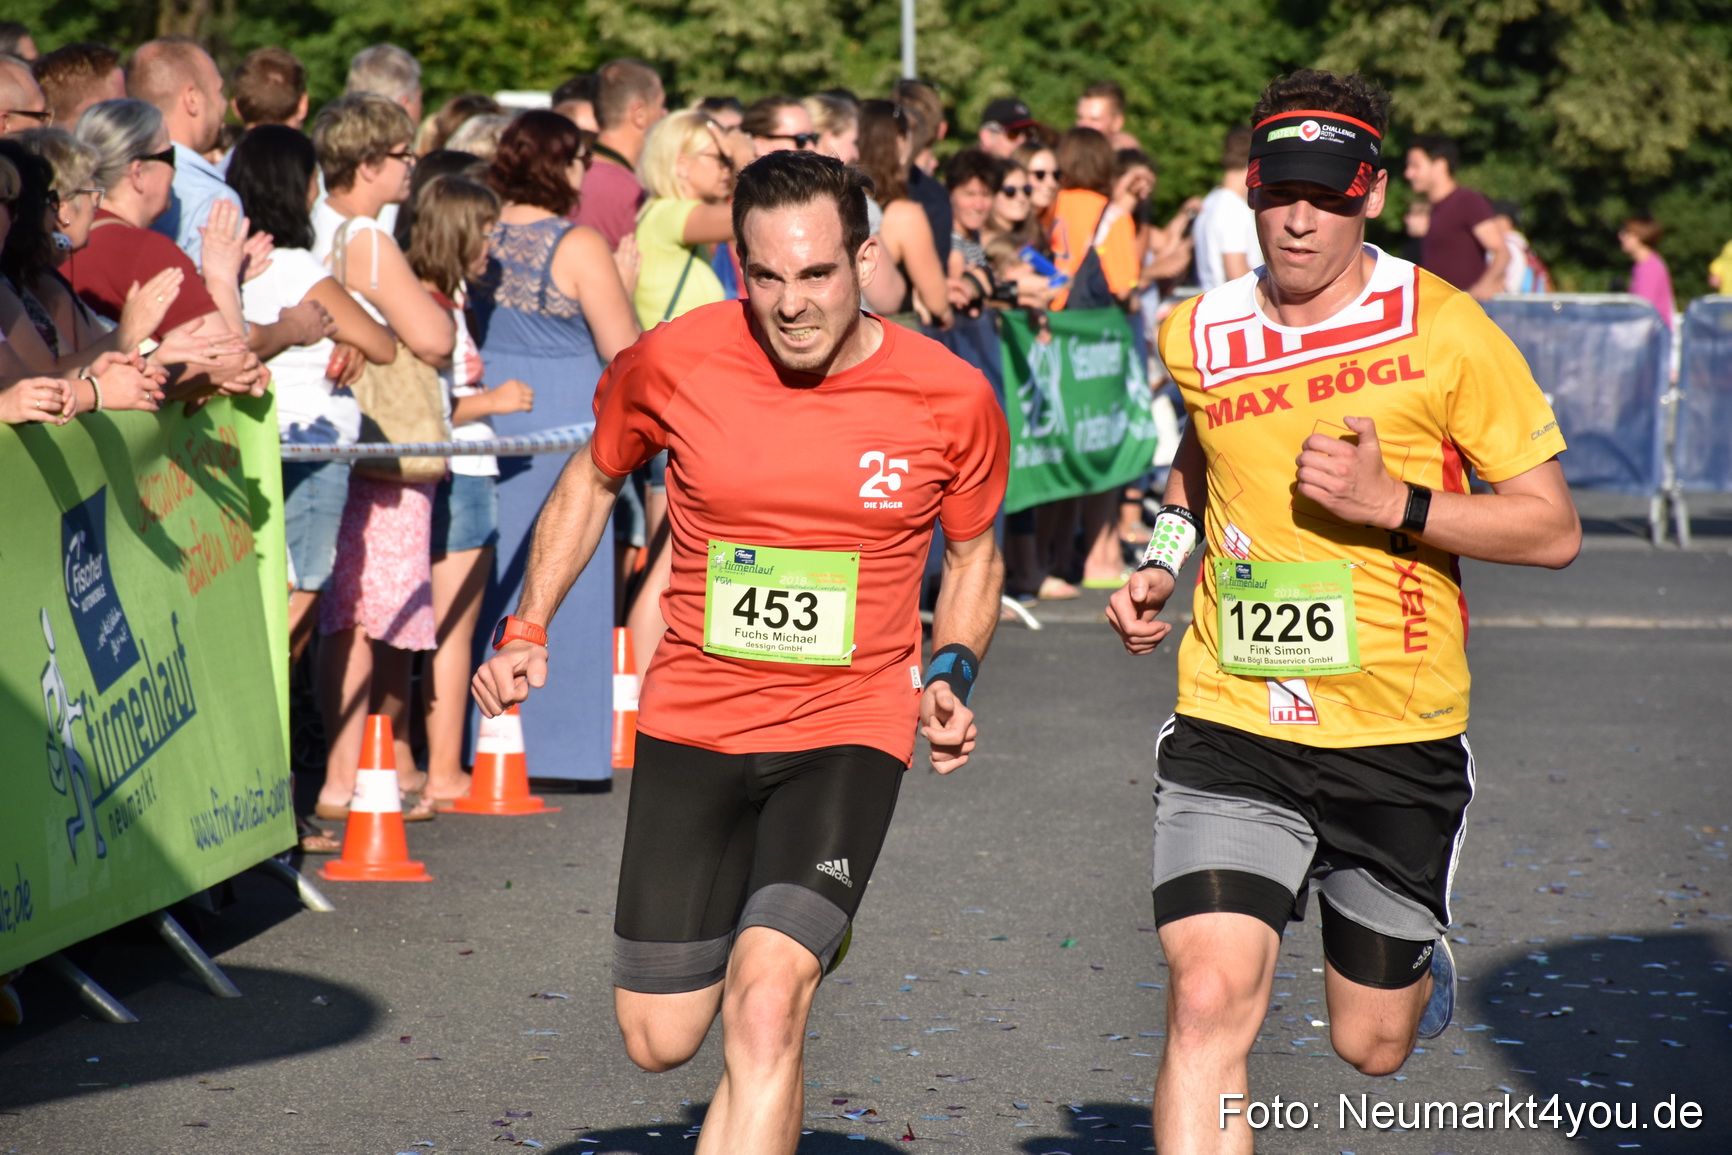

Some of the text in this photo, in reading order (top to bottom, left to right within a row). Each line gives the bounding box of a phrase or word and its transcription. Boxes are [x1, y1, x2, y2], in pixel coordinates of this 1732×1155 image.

[1270, 127, 1296, 139] DATEV
[1320, 130, 1335, 138] ROTH
[1322, 124, 1356, 139] CHALLENGE
[1205, 383, 1293, 430] MAX
[1307, 354, 1425, 403] BÖGL
[859, 451, 908, 498] 25
[864, 500, 903, 509] DIE JÄGER
[725, 560, 775, 575] firmenlauf
[71, 553, 103, 598] Fischer
[779, 575, 808, 586] 2018
[1229, 576, 1268, 589] firmenlauf
[1273, 588, 1300, 598] 2018
[733, 587, 818, 631] 453
[1230, 601, 1334, 642] 1226
[735, 628, 817, 644] Fuchs Michael
[746, 641, 803, 653] dessign GmbH
[1250, 644, 1311, 656] Fink Simon
[1233, 655, 1333, 666] Max Bögl Bauservice GmbH
[81, 611, 196, 797] firmenlauf
[108, 768, 157, 840] neumarkt
[816, 863, 853, 889] adidas
